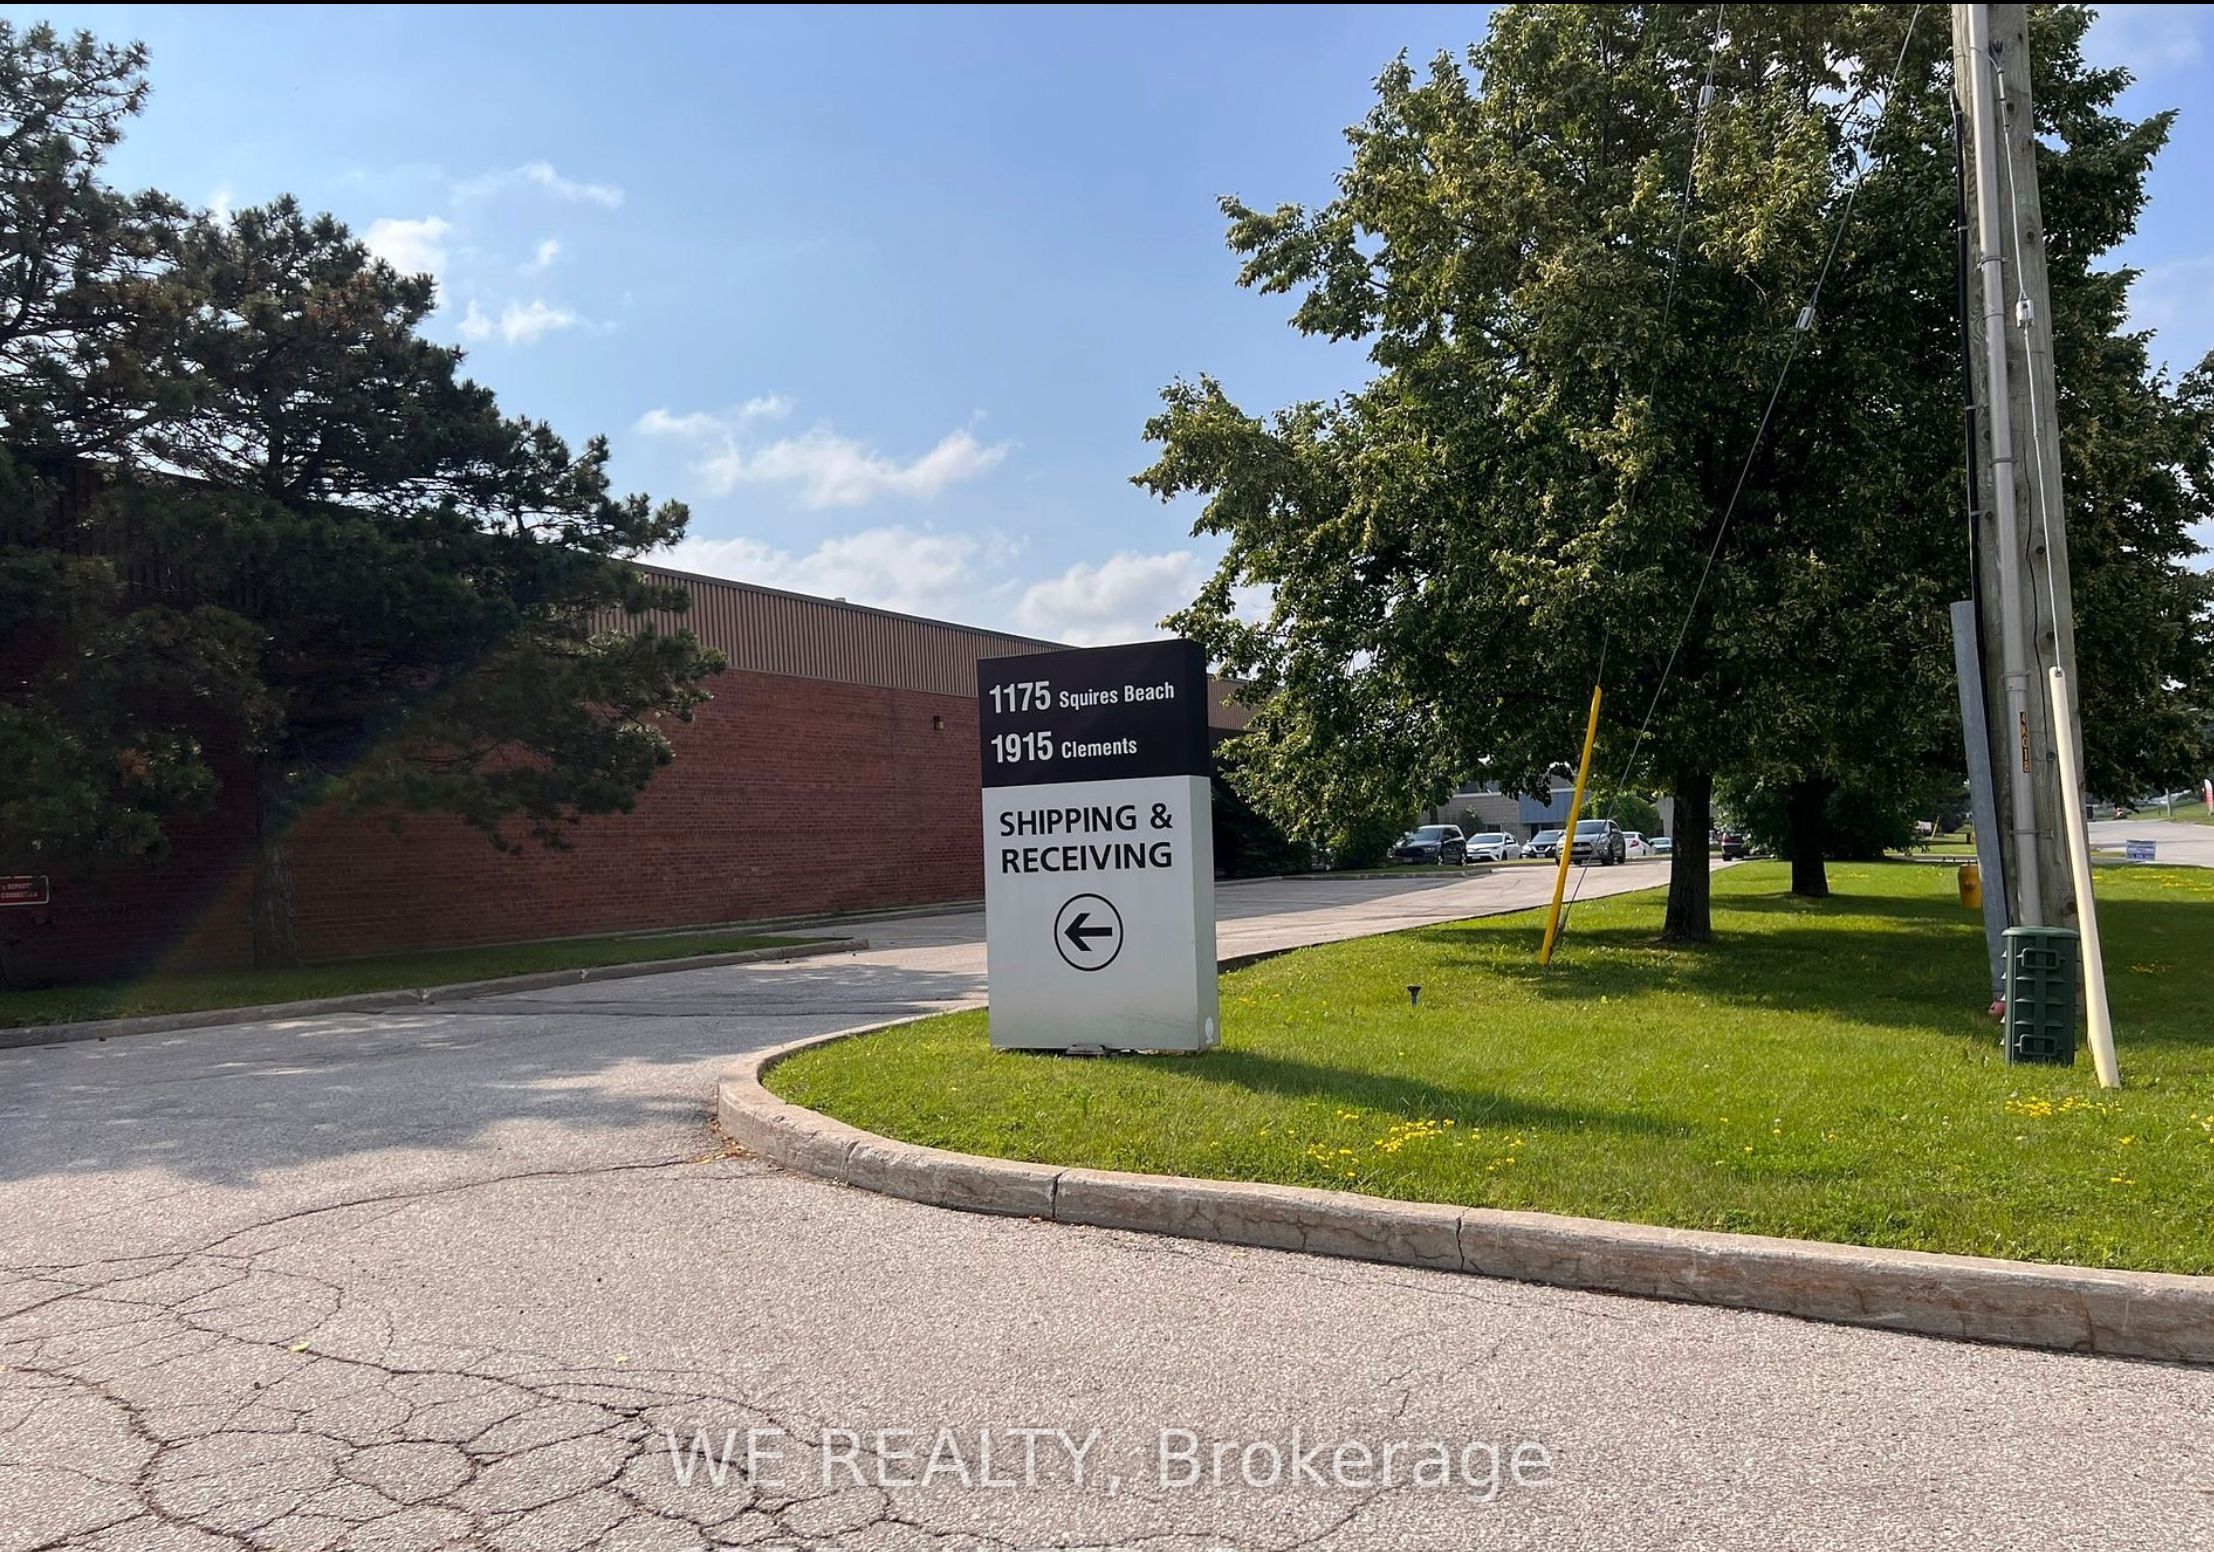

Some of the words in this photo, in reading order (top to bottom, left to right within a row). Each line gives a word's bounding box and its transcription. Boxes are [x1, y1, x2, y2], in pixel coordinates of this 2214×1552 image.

[989, 681, 1051, 713] 1175
[1059, 689, 1119, 710] Squires
[1124, 682, 1175, 702] Beach
[991, 731, 1053, 763] 1915
[1061, 738, 1138, 758] Clements
[999, 805, 1137, 837] SHIPPING
[1150, 803, 1173, 829] &
[1002, 842, 1172, 874] RECEIVING
